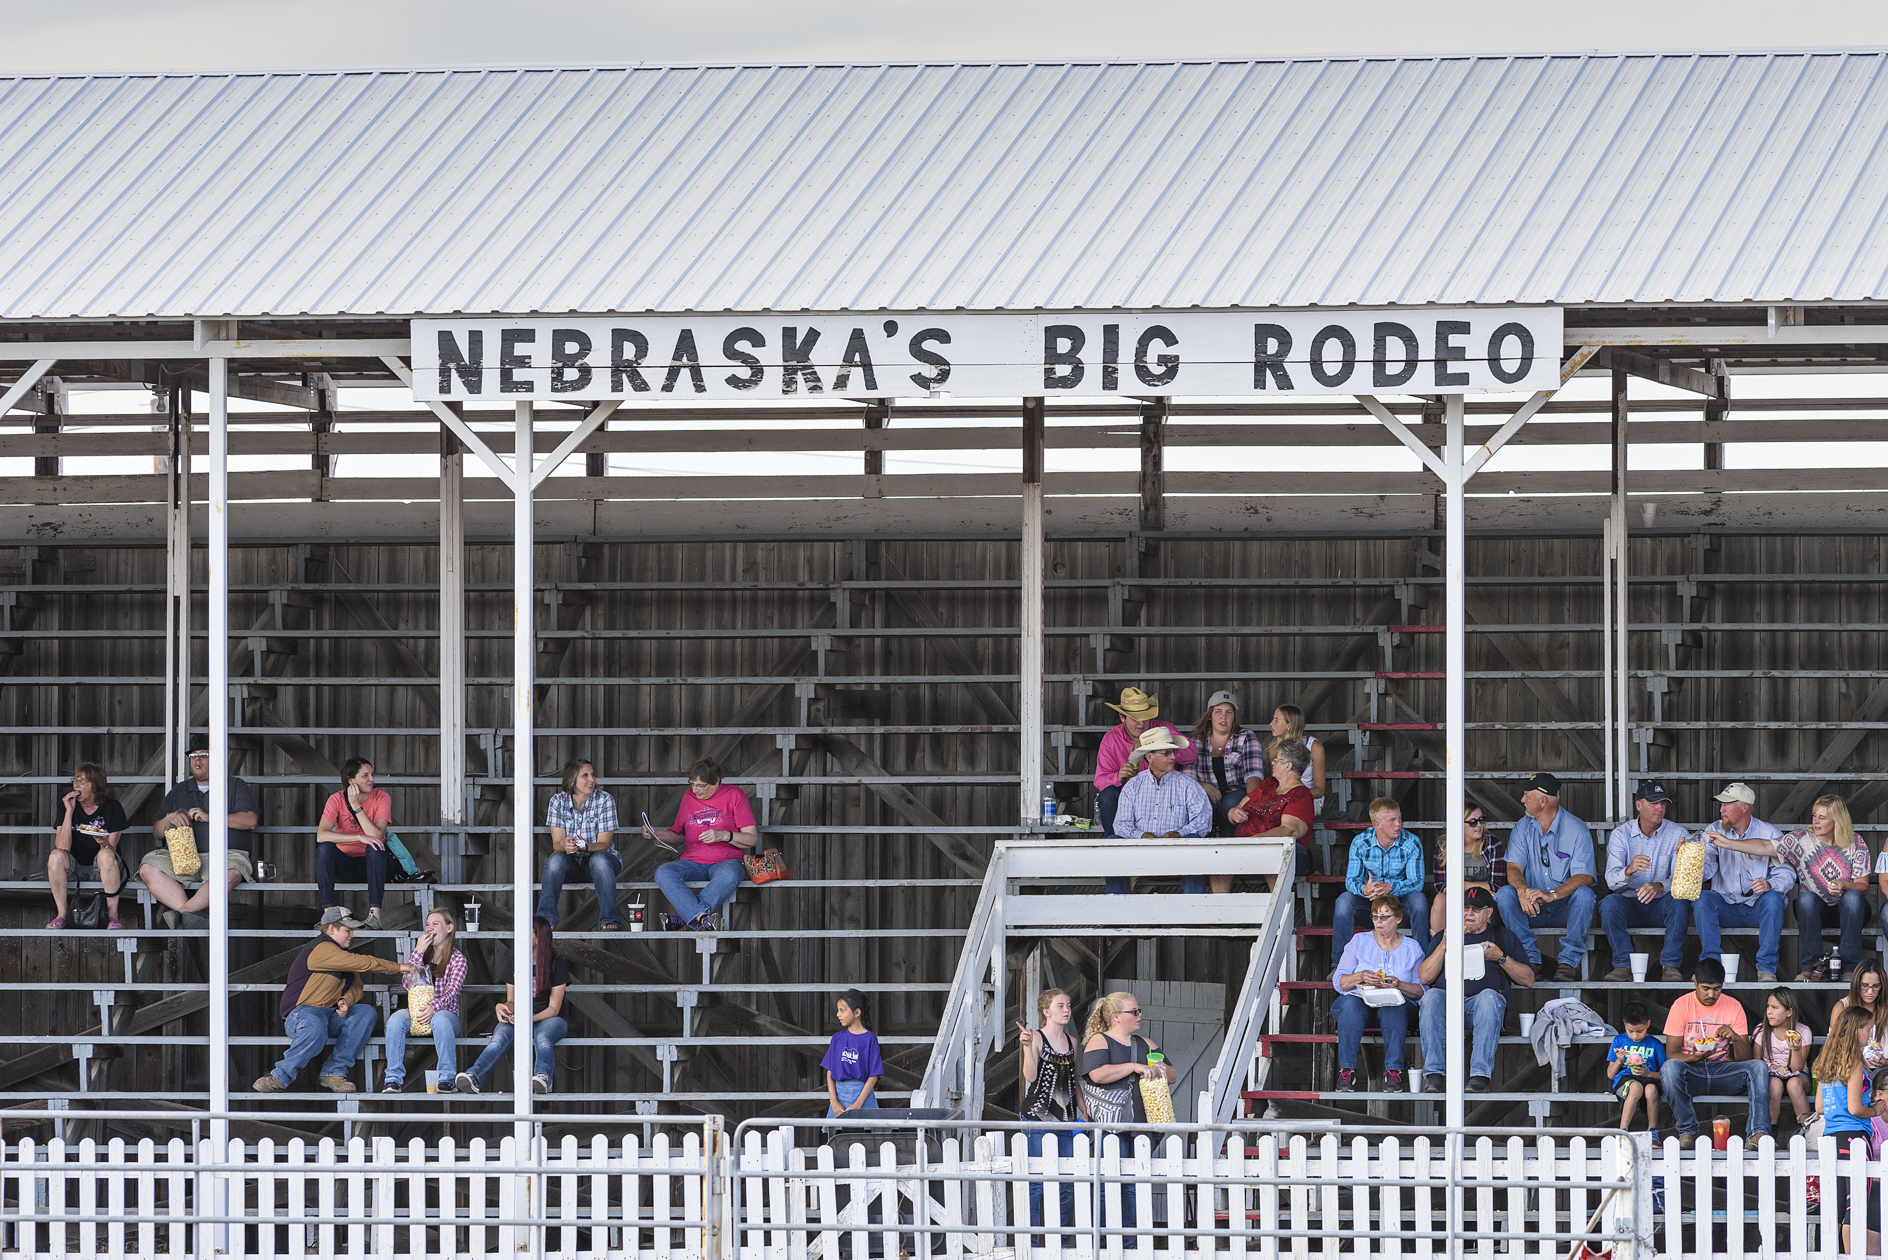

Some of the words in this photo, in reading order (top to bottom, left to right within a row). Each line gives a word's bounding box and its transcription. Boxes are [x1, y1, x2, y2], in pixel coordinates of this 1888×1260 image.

[437, 319, 952, 395] NEBRASKA'S
[1043, 323, 1180, 391] BIG
[1252, 320, 1535, 390] RODEO
[1468, 889, 1477, 898] N
